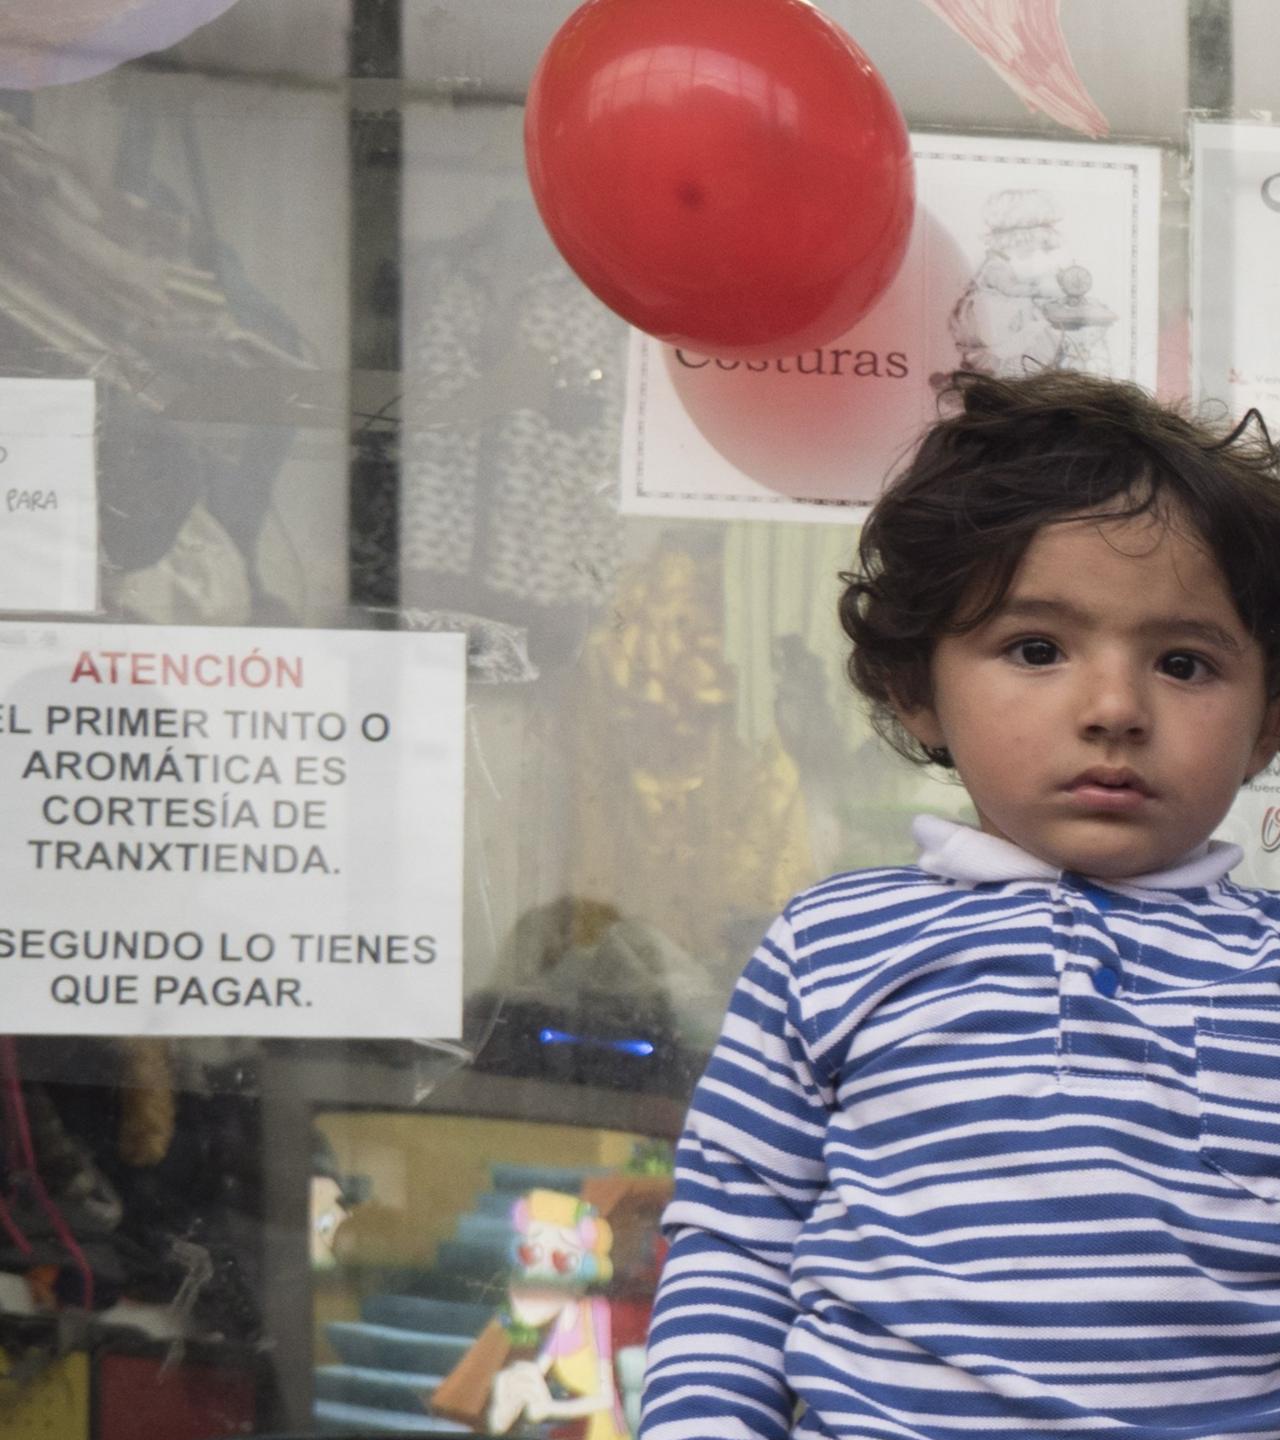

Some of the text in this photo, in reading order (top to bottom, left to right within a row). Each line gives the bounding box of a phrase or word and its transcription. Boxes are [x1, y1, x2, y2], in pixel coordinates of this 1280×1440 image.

[6, 488, 59, 512] PARA
[70, 648, 304, 689] ATENCIÓN
[47, 705, 209, 738] PRIMER
[223, 709, 347, 741] TINTO
[361, 713, 391, 742] O
[21, 746, 347, 785] AROMÁTICA ES
[42, 791, 328, 829] CORTESÍA DE
[28, 839, 341, 875] TRANXTIENDA.
[0, 929, 438, 964] SEGUNDO LO TIENES
[50, 973, 313, 1007] QUE PAGAR.
